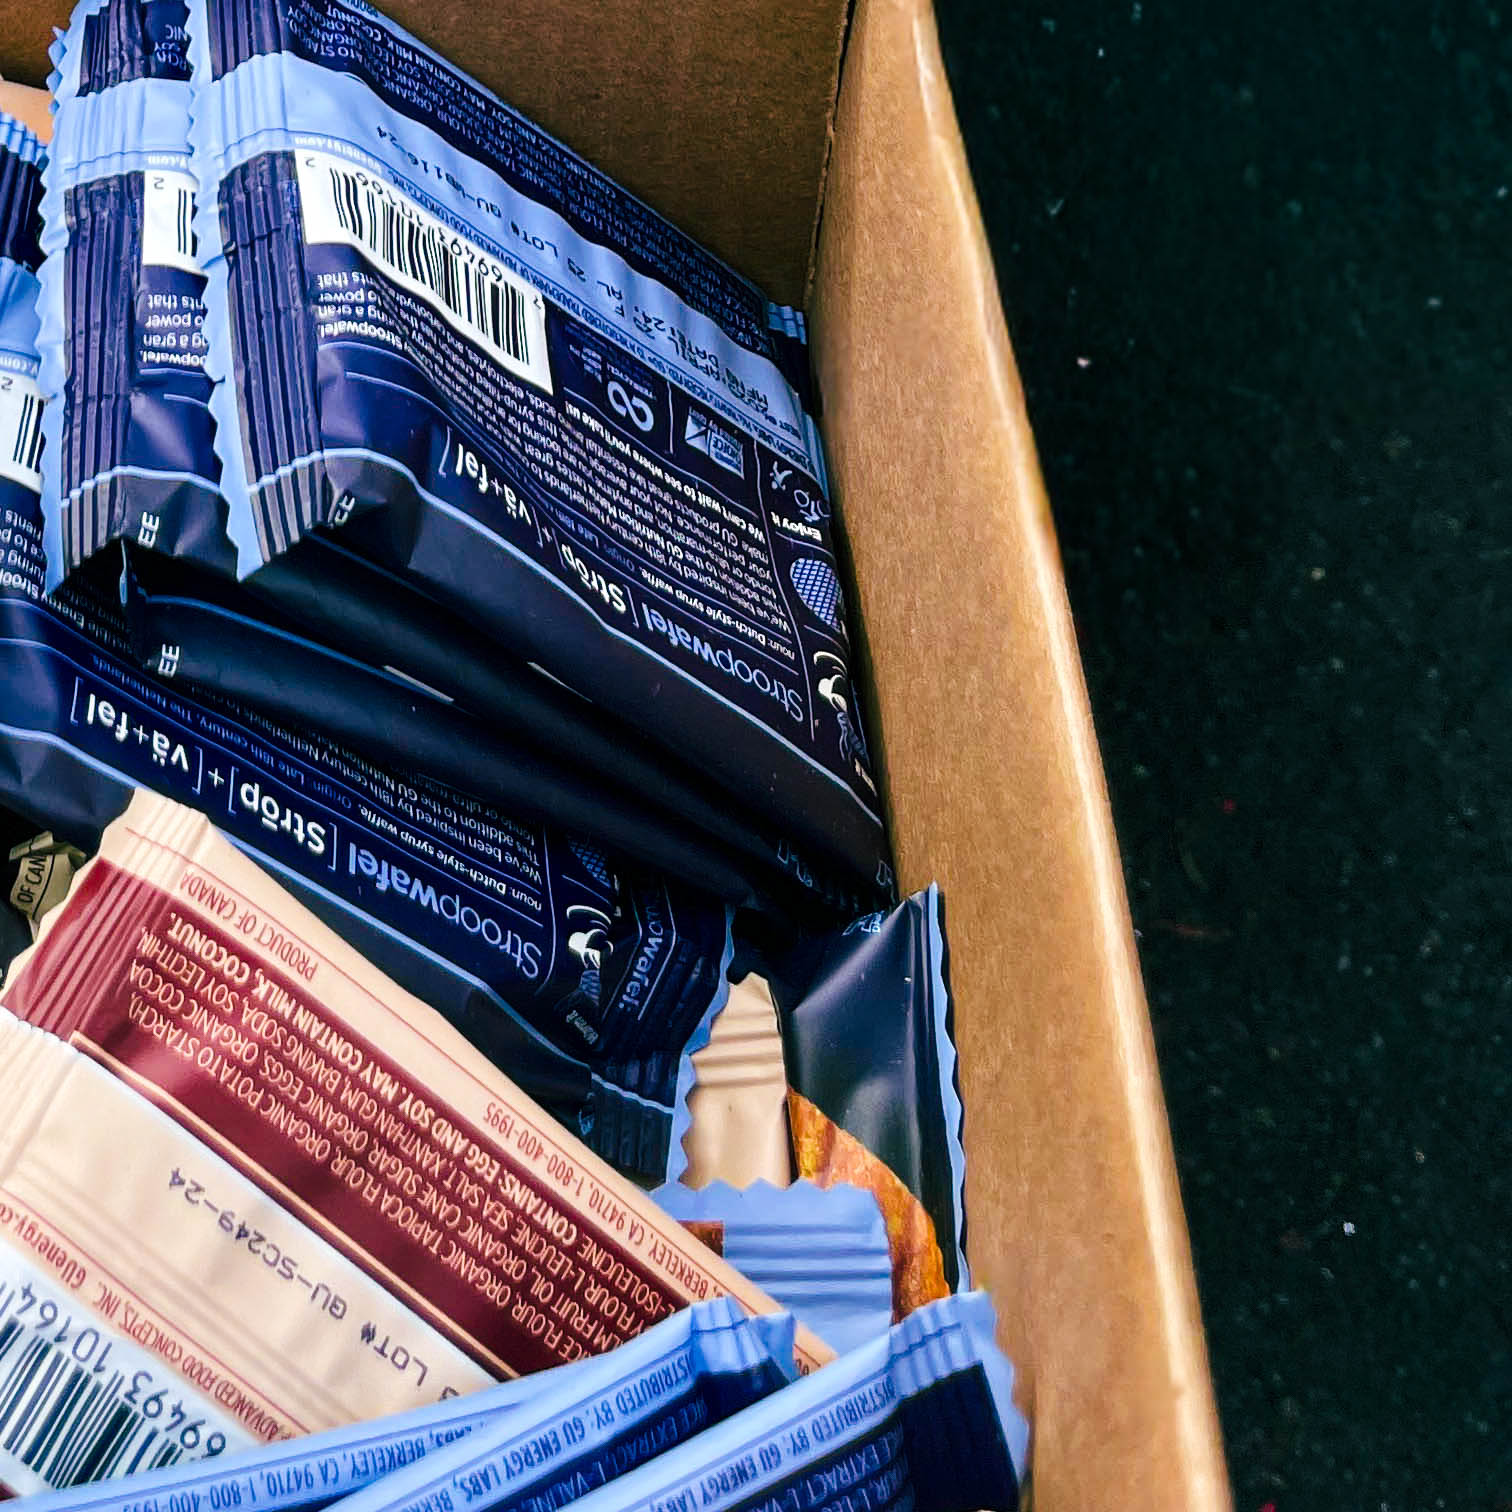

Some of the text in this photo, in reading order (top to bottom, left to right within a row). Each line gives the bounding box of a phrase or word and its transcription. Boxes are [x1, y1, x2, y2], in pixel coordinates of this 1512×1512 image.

[146, 313, 189, 329] power
[147, 294, 182, 312] that
[142, 334, 175, 349] gran
[780, 510, 825, 549] Enjoy
[633, 561, 770, 653] Dutch-style syrup waffle.
[643, 594, 806, 726] Stroopwafel
[398, 832, 435, 857] syrup
[415, 806, 467, 850] inspired
[459, 814, 511, 848] addition
[467, 838, 503, 863] been
[16, 888, 35, 905] OF
[435, 848, 507, 897] Dutch-style
[346, 837, 544, 980] Stroopwafel
[158, 906, 584, 1247] CONTAINS: EGG AND SOY. MAY CONTAIN MILK, COCONUT.
[173, 864, 715, 1299] BERKELEY, CA 94710, 1-800-400-1995 PRODUCT OF CANADA
[121, 954, 598, 1337] FRUIT OIL, ORGANIC CANE SUGAR, ORGANIC EGGS, ORGANIC COCOA
[127, 921, 640, 1330] FLOUR, L-LEUCINE, SEA SALT, XANTHAN GUM, BAKING SODA, SOY LECITHIN,
[118, 987, 568, 1350] FLOUR, ORGANIC TAPIOCA FLOUR, ORGANIC POTATO STARCH),
[84, 1278, 125, 1318] INC.
[156, 1164, 434, 1388] LOT# GU-SC249-24
[18, 1284, 116, 1376] 10164
[130, 1368, 228, 1460] 69493
[176, 1350, 221, 1392] FOOD
[496, 1429, 565, 1479] ENERGY
[559, 1415, 588, 1445] GU
[259, 1433, 428, 1499] BERKELEY, CA 94710,
[450, 1460, 504, 1504] LABS,
[693, 1441, 785, 1505] GU ENERGY
